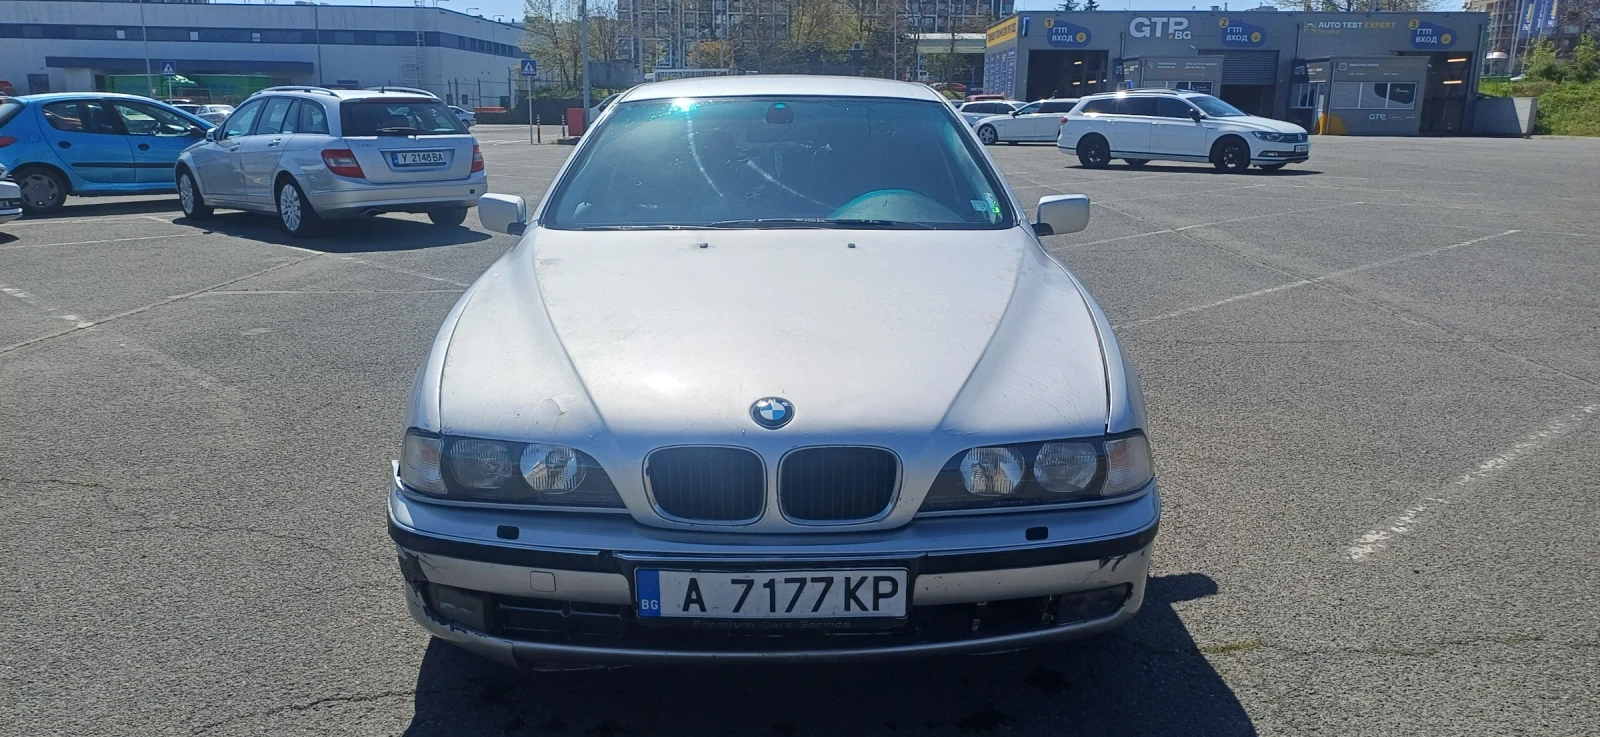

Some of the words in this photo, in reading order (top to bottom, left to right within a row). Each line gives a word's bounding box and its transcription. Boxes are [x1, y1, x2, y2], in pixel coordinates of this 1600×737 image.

[1046, 19, 1052, 27] 1
[1221, 18, 1227, 27] 2
[1318, 21, 1341, 29] AUTO
[1342, 21, 1363, 29] TEST
[1410, 20, 1416, 28] 3
[1129, 17, 1188, 38] GTP
[1052, 34, 1074, 43] ВХОД
[1226, 34, 1248, 43] ВХОД
[1415, 36, 1438, 44] ВХОД
[681, 577, 707, 613] A
[641, 599, 659, 610] BG
[692, 619, 755, 628] Premium
[761, 620, 793, 628] Cars
[798, 619, 852, 628] Service
